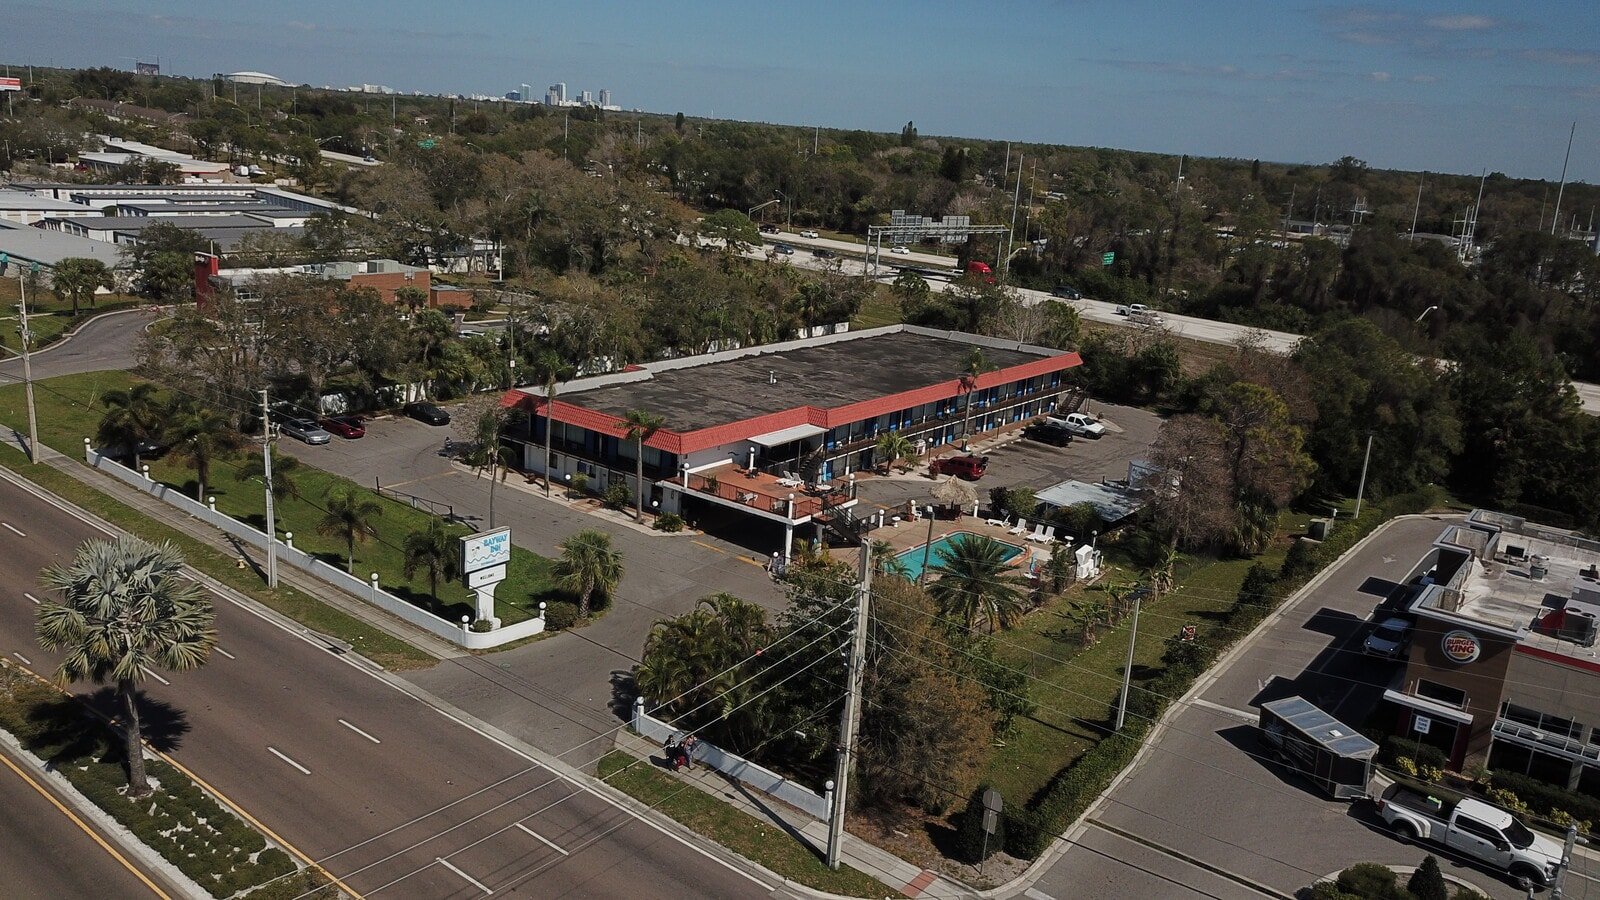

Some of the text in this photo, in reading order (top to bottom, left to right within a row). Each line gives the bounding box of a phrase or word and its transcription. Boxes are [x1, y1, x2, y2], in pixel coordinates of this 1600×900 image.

[484, 534, 507, 546] BAYWAY
[490, 544, 501, 553] INN
[1447, 638, 1475, 646] BURGER
[1446, 644, 1475, 653] KING
